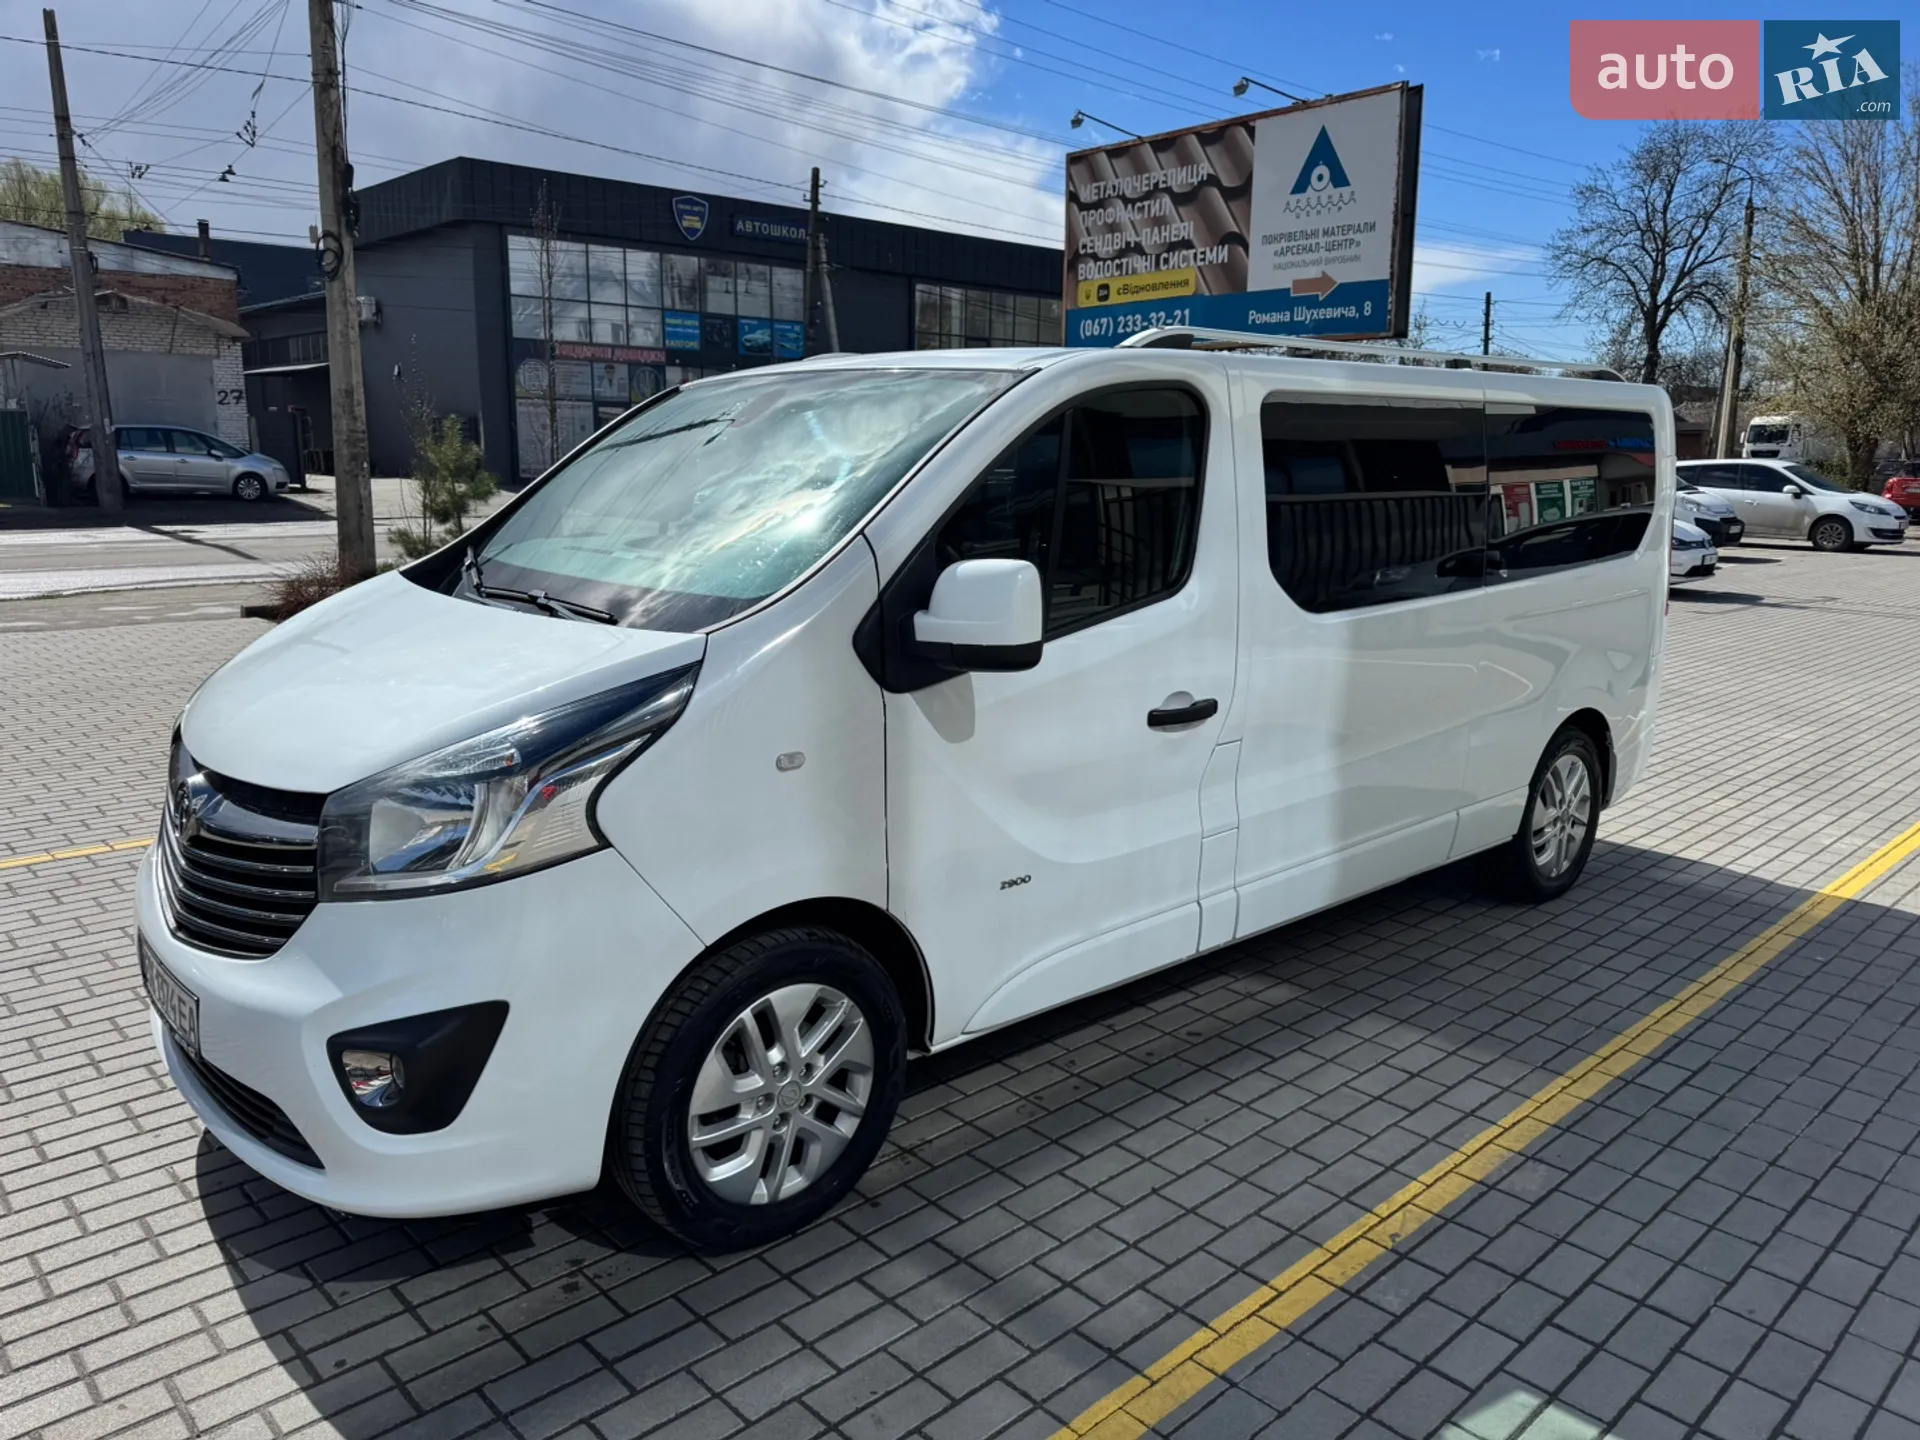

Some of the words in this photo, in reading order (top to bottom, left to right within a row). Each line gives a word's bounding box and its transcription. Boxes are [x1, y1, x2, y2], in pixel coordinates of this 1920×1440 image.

[1080, 163, 1208, 201] МЕТАЛОЧЕРЕПИЦЯ
[1079, 198, 1171, 228] ПРОФНАСТИЛ
[736, 220, 810, 240] АВТОШКОЛ
[1078, 221, 1194, 254] СЕНДВІЧ-ПАНЕЛІ
[1261, 228, 1320, 246] ПОКРІВЕЛЬНІ
[1322, 221, 1377, 239] МАТЕРІАЛИ
[1078, 253, 1155, 280] ВОДОСТІЧНІ
[1160, 244, 1228, 270] СИСТЕМИ
[1080, 317, 1114, 339] (067)
[1117, 308, 1190, 333] 233-32-21
[1248, 310, 1290, 324] Романа
[1293, 305, 1359, 324] Шухевича,
[1363, 301, 1372, 316] 8
[218, 390, 244, 405] 27
